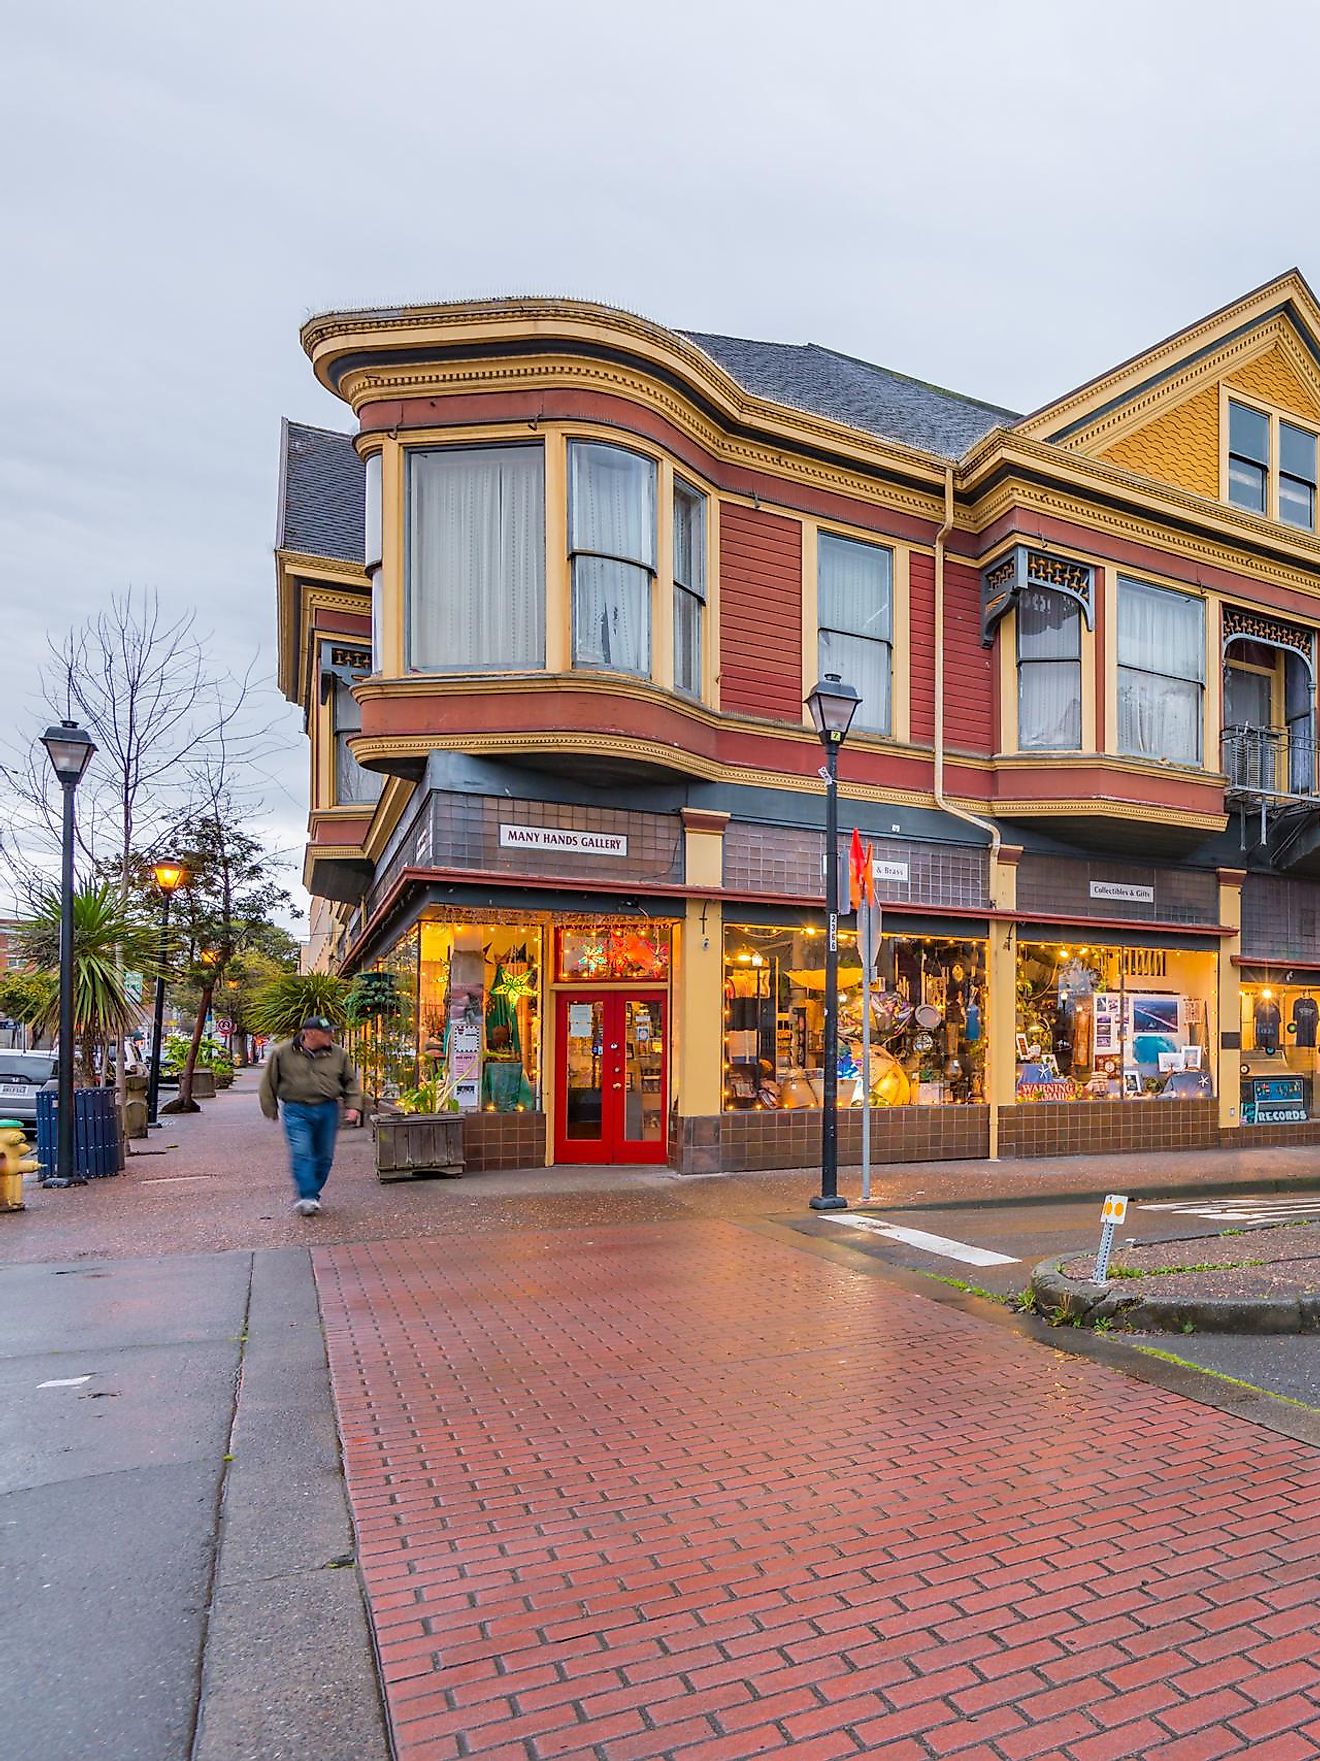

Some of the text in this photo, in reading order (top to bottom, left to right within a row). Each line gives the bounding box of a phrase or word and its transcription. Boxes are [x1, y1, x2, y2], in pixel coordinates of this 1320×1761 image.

[508, 830, 621, 849] MANY HANDS GALLERY
[885, 867, 904, 876] Brass
[1094, 886, 1129, 896] Collectibles
[1136, 890, 1150, 898] Gifts
[1022, 1083, 1075, 1094] WARNING
[1258, 1110, 1307, 1122] RECORDS
